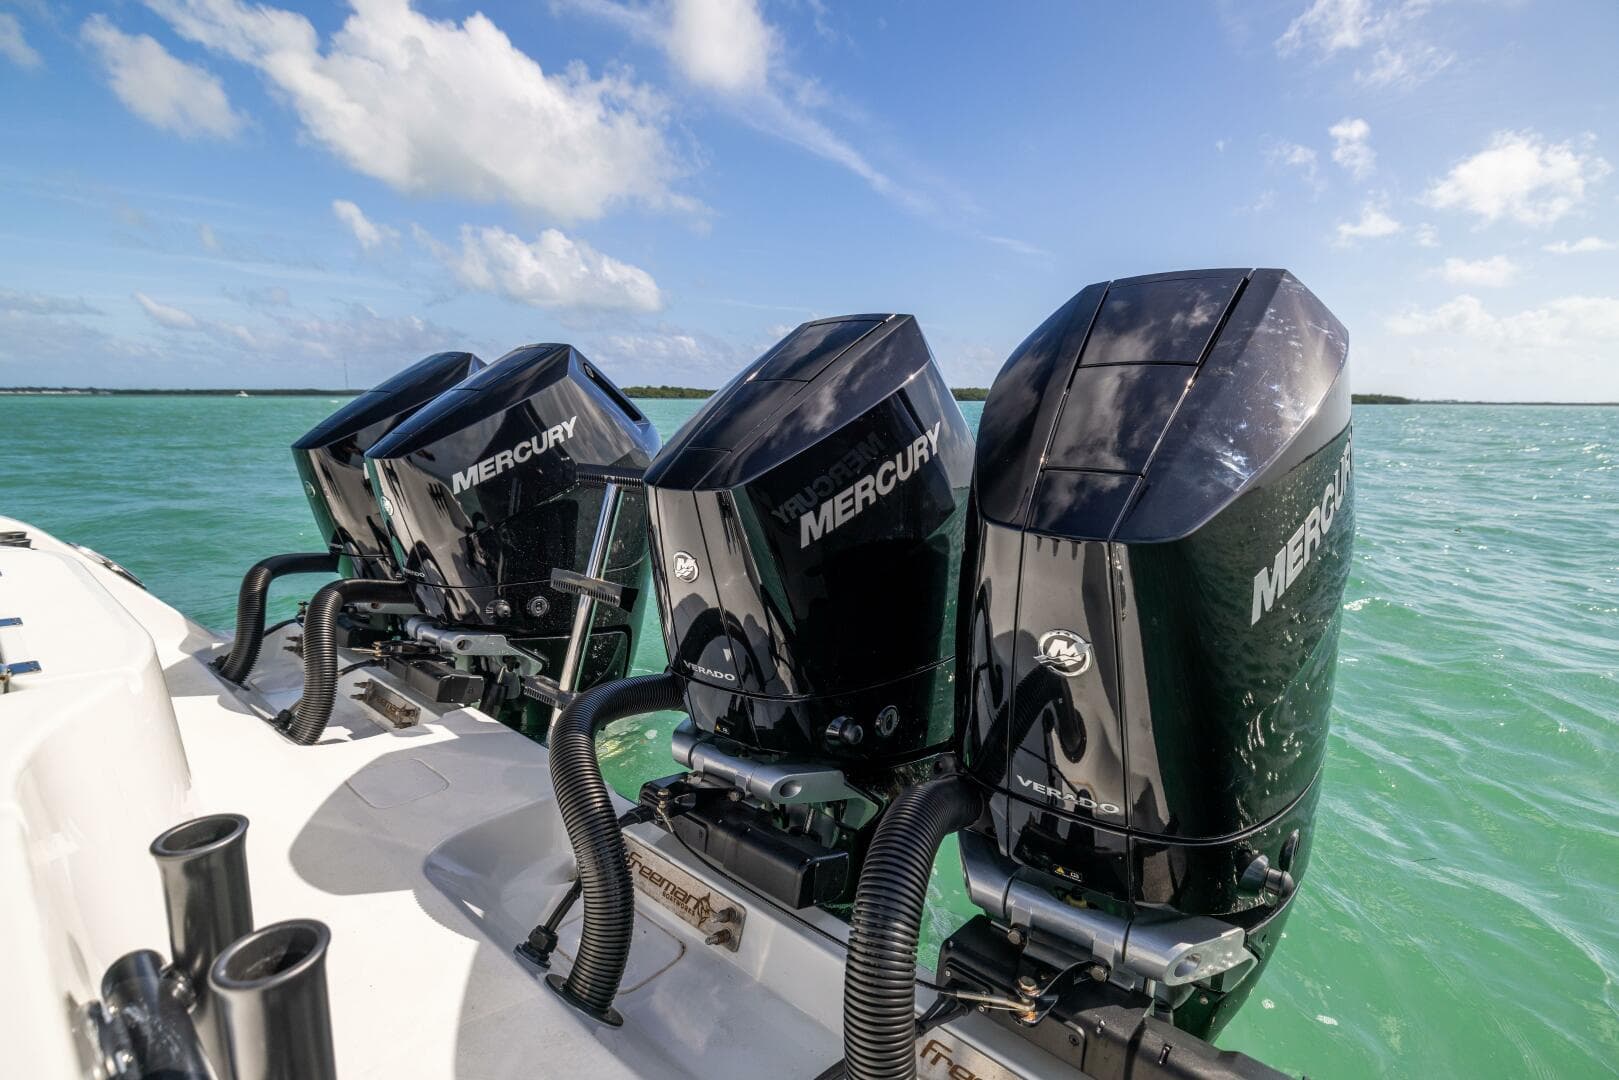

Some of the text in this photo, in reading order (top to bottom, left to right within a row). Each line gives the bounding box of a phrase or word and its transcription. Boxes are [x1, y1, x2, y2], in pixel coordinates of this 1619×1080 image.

[452, 415, 577, 495] MERCURY
[800, 421, 941, 549] MERCURY
[1251, 432, 1353, 627] MERCUR
[683, 659, 736, 681] VERADO
[1016, 774, 1120, 815] VERADO
